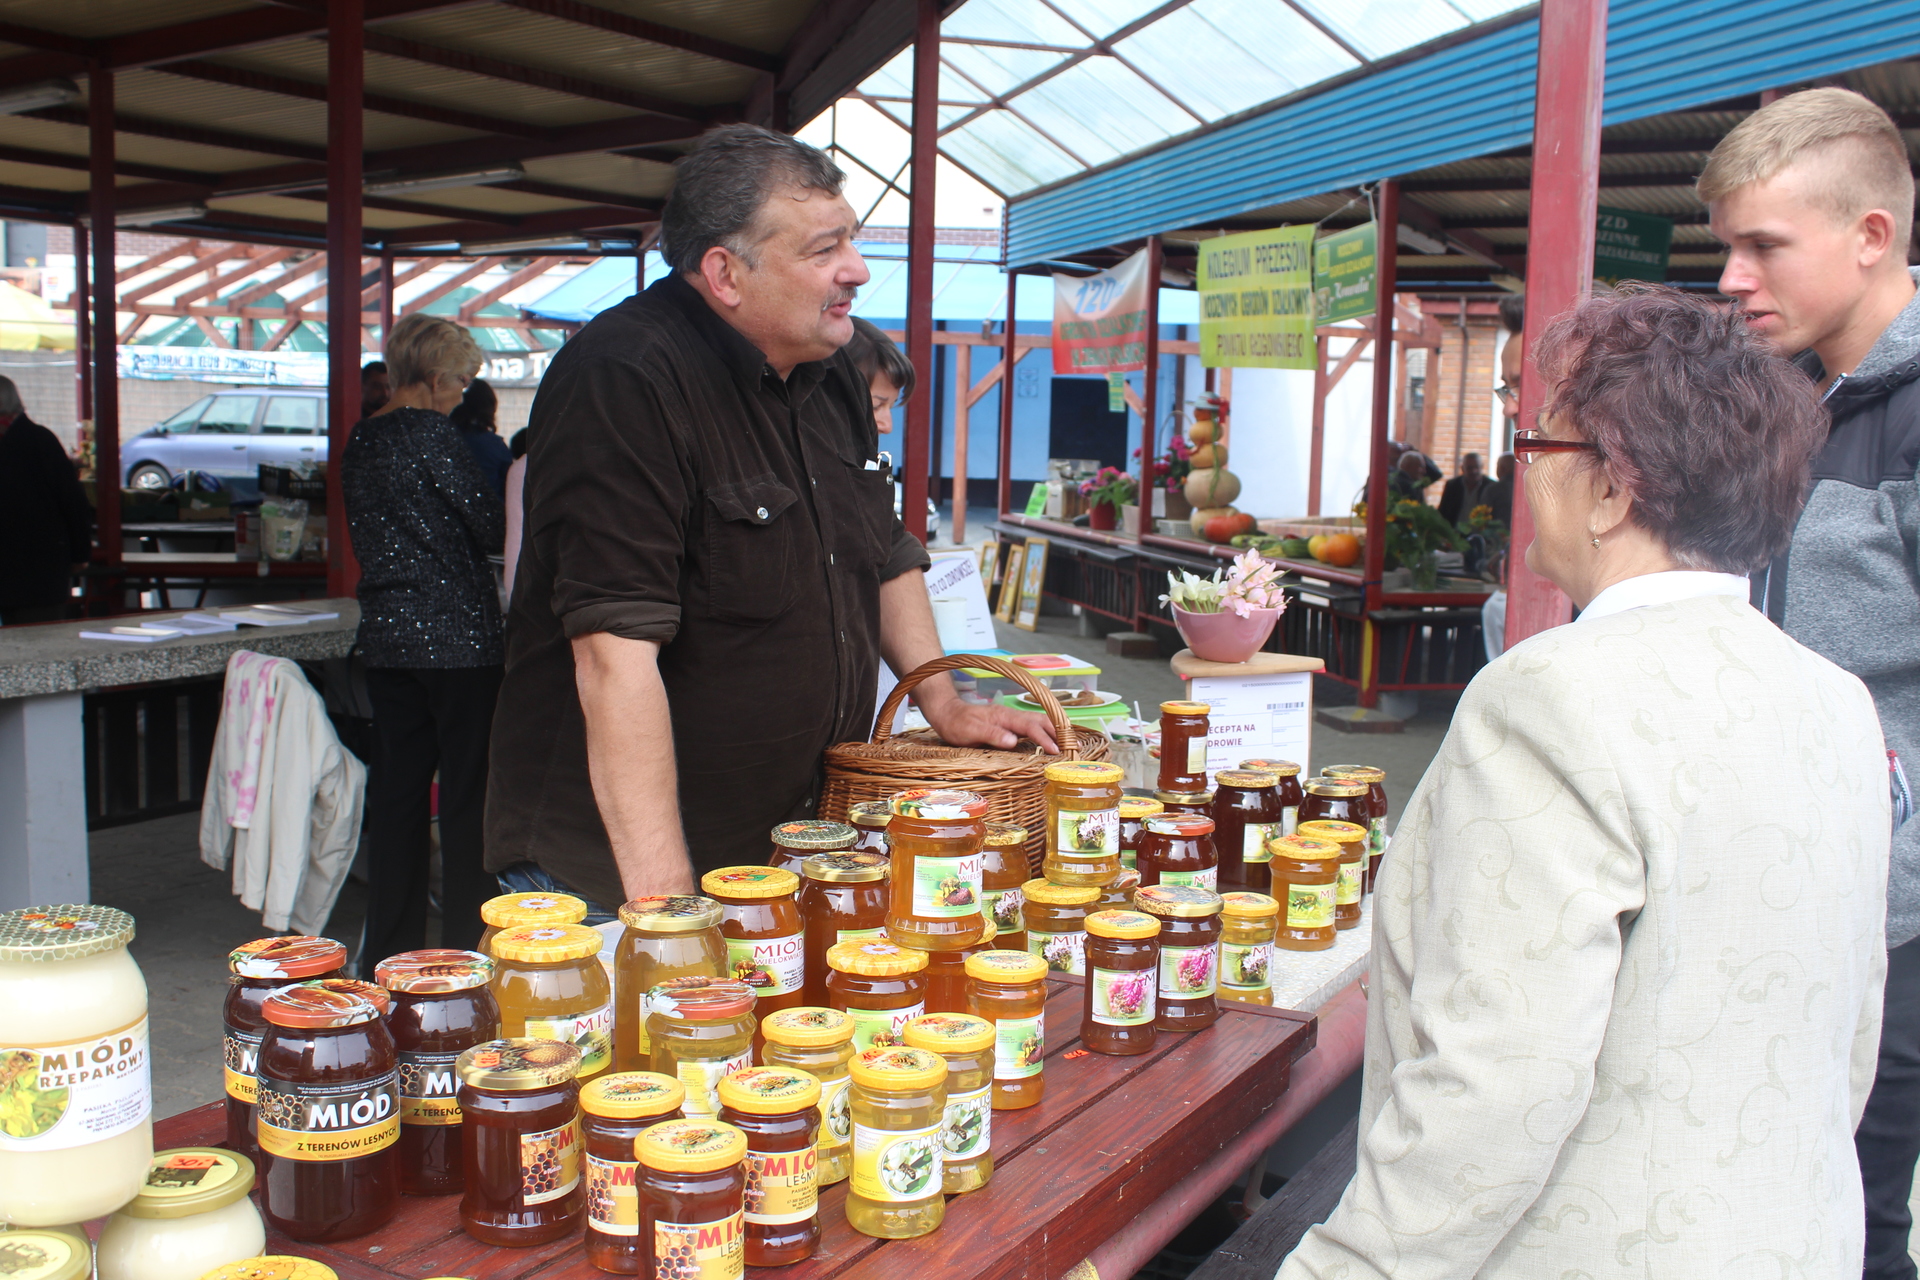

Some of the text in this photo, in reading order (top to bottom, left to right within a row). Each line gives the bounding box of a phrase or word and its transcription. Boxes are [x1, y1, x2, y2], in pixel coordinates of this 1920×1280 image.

[1207, 236, 1309, 279] KOLEGIUM PREZESÓW
[1075, 277, 1117, 314] 120
[491, 357, 524, 379] na
[1244, 724, 1256, 732] NA
[754, 937, 804, 958] MIÓD
[41, 1048, 144, 1088] RZEPAKOWY
[42, 1037, 133, 1073] MIÓD
[309, 1091, 391, 1129] MIÓD
[413, 1108, 420, 1117] Z
[297, 1125, 397, 1152] Z TERENÓW LEŚNYCH
